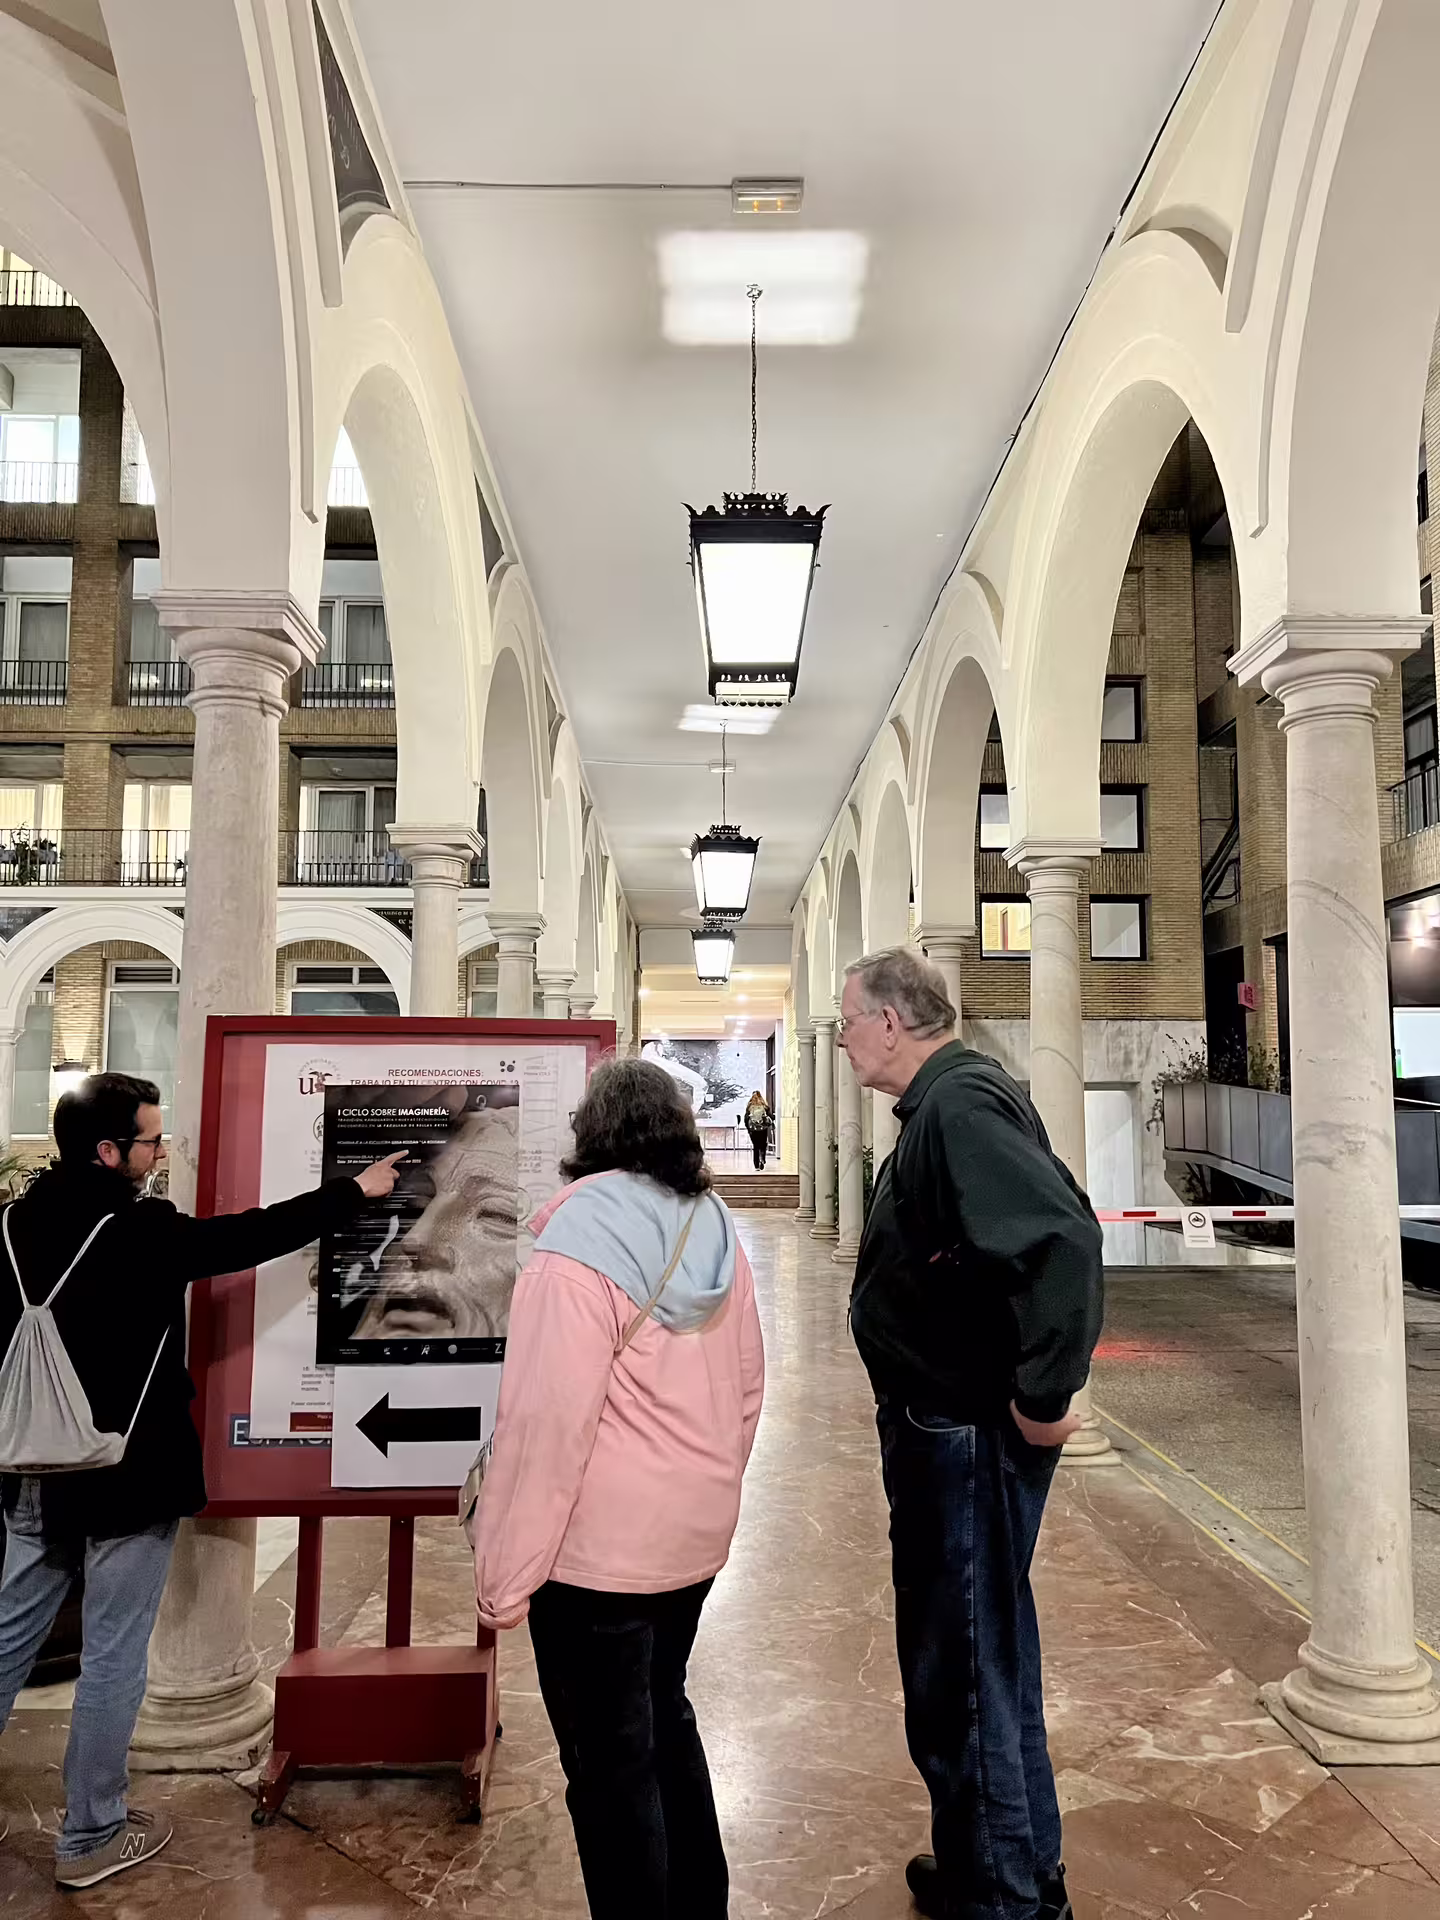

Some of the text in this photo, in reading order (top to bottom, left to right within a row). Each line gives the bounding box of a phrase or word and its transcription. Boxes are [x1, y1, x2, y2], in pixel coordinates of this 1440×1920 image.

[388, 1068, 484, 1077] RECOMENDACIONES:
[342, 1108, 370, 1117] CICLO
[370, 1108, 397, 1117] SOBRE
[398, 1106, 450, 1116] IMAGINERÍA:
[119, 1833, 146, 1859] N
